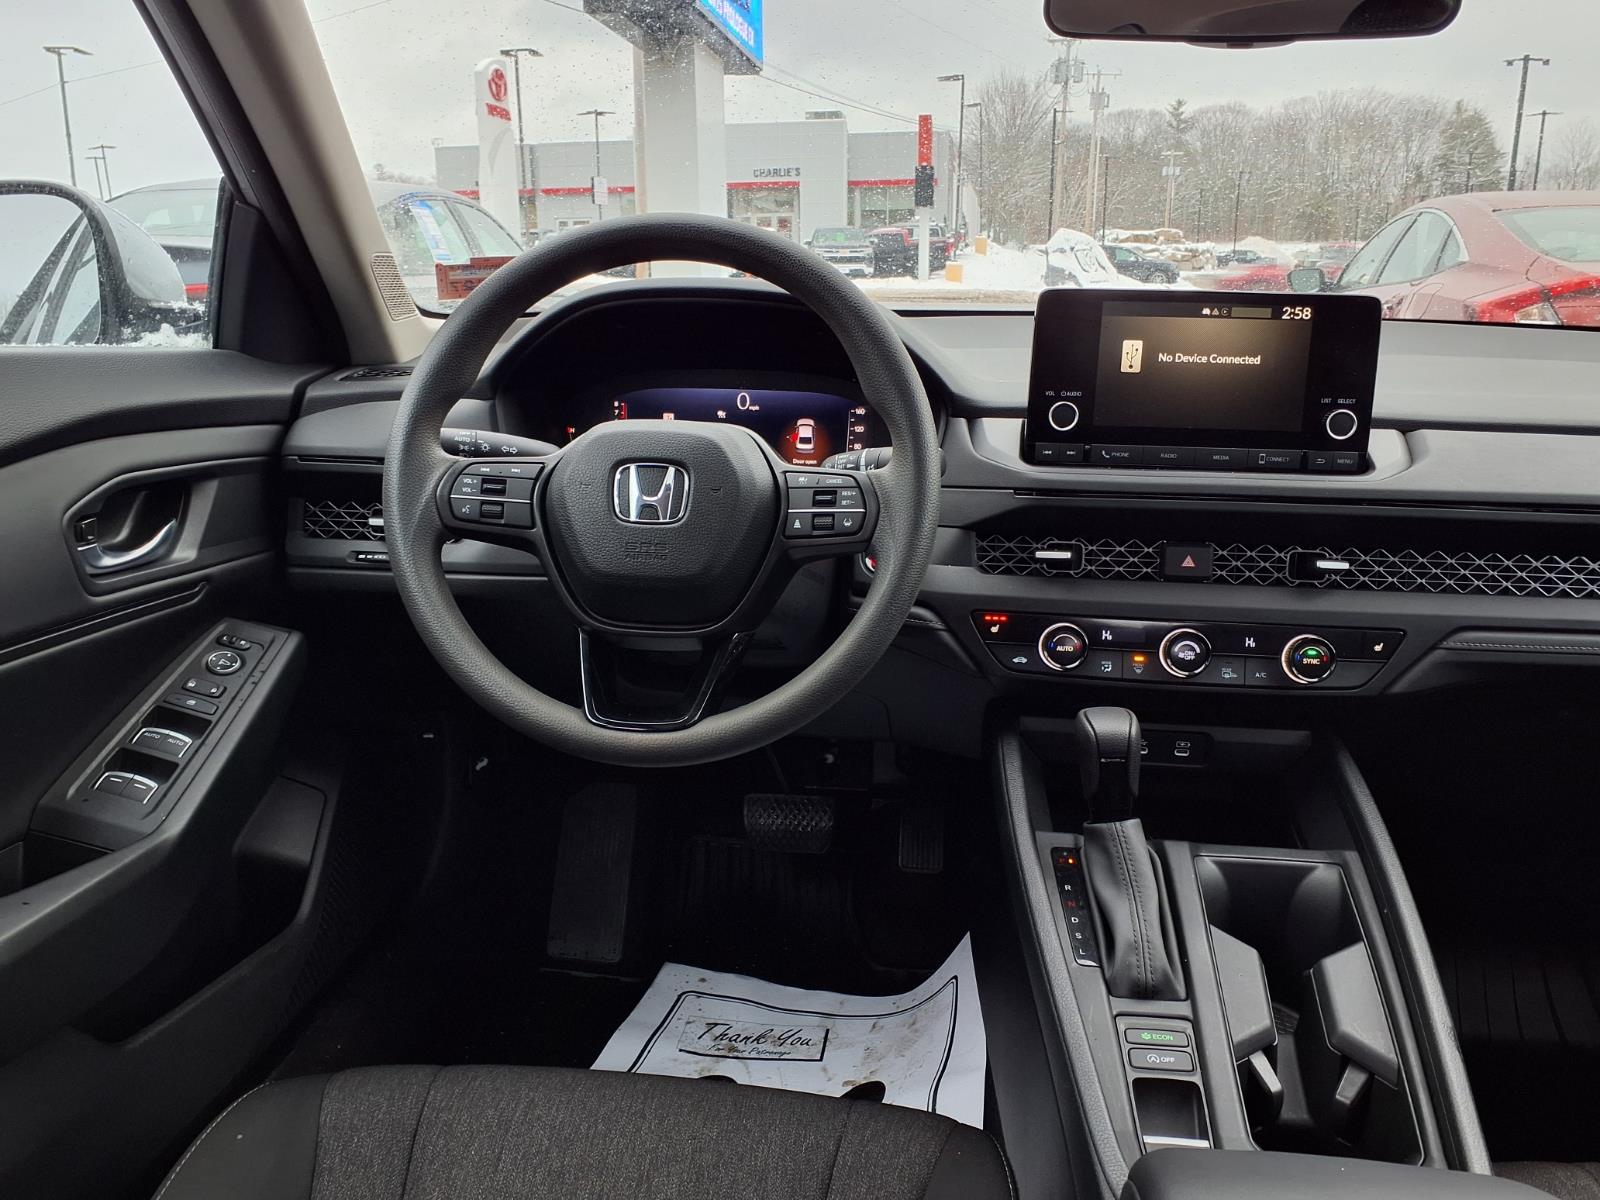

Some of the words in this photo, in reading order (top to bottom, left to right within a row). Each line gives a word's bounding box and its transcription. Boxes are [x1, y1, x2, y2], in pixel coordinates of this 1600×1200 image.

[753, 167, 801, 177] CHARLIE'S
[1281, 306, 1312, 320] 2:58
[1159, 353, 1173, 362] No
[1175, 353, 1208, 363] Device
[1210, 354, 1261, 365] Connected
[737, 392, 749, 410] 0
[1255, 671, 1267, 679] A/C
[144, 731, 161, 739] AUTO
[167, 737, 184, 746] AUTO
[697, 1021, 774, 1045] Thank
[777, 1028, 813, 1047] You
[1152, 1033, 1174, 1041] ECON
